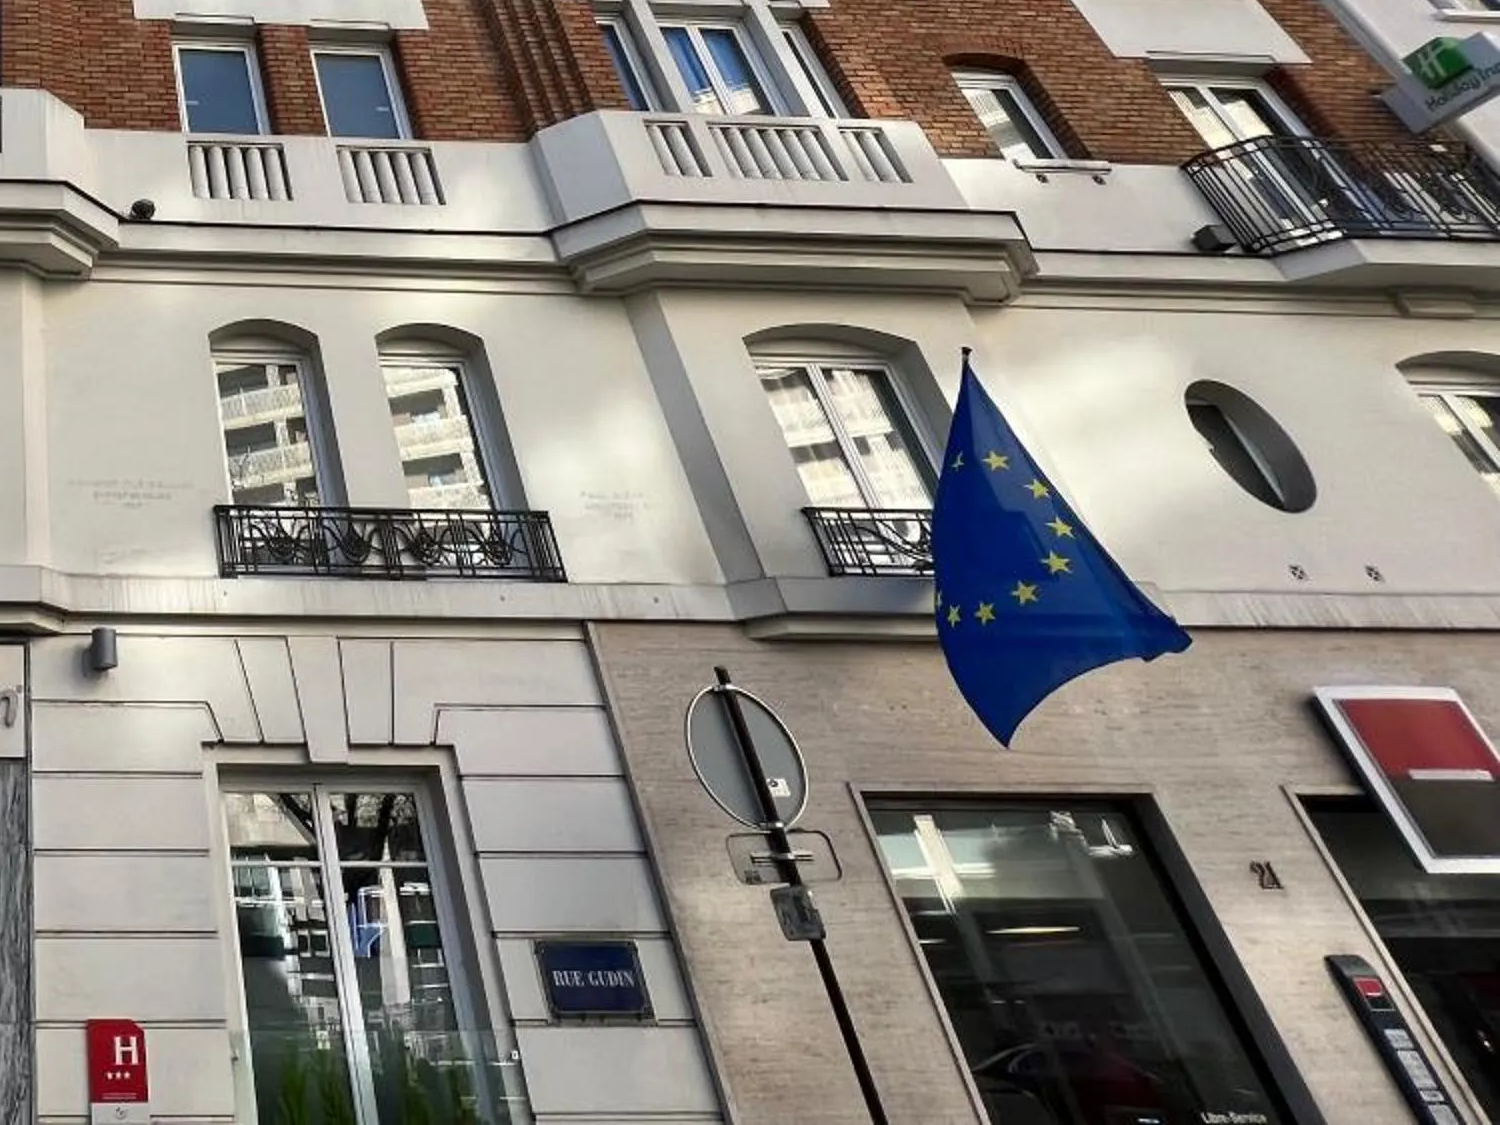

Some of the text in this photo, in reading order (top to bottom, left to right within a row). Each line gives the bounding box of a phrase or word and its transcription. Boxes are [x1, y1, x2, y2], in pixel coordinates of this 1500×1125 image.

[1424, 74, 1481, 113] Holday
[552, 970, 635, 988] RUE GUDIN
[113, 1036, 139, 1066] H
[1200, 1111, 1268, 1124] Libre-Service
